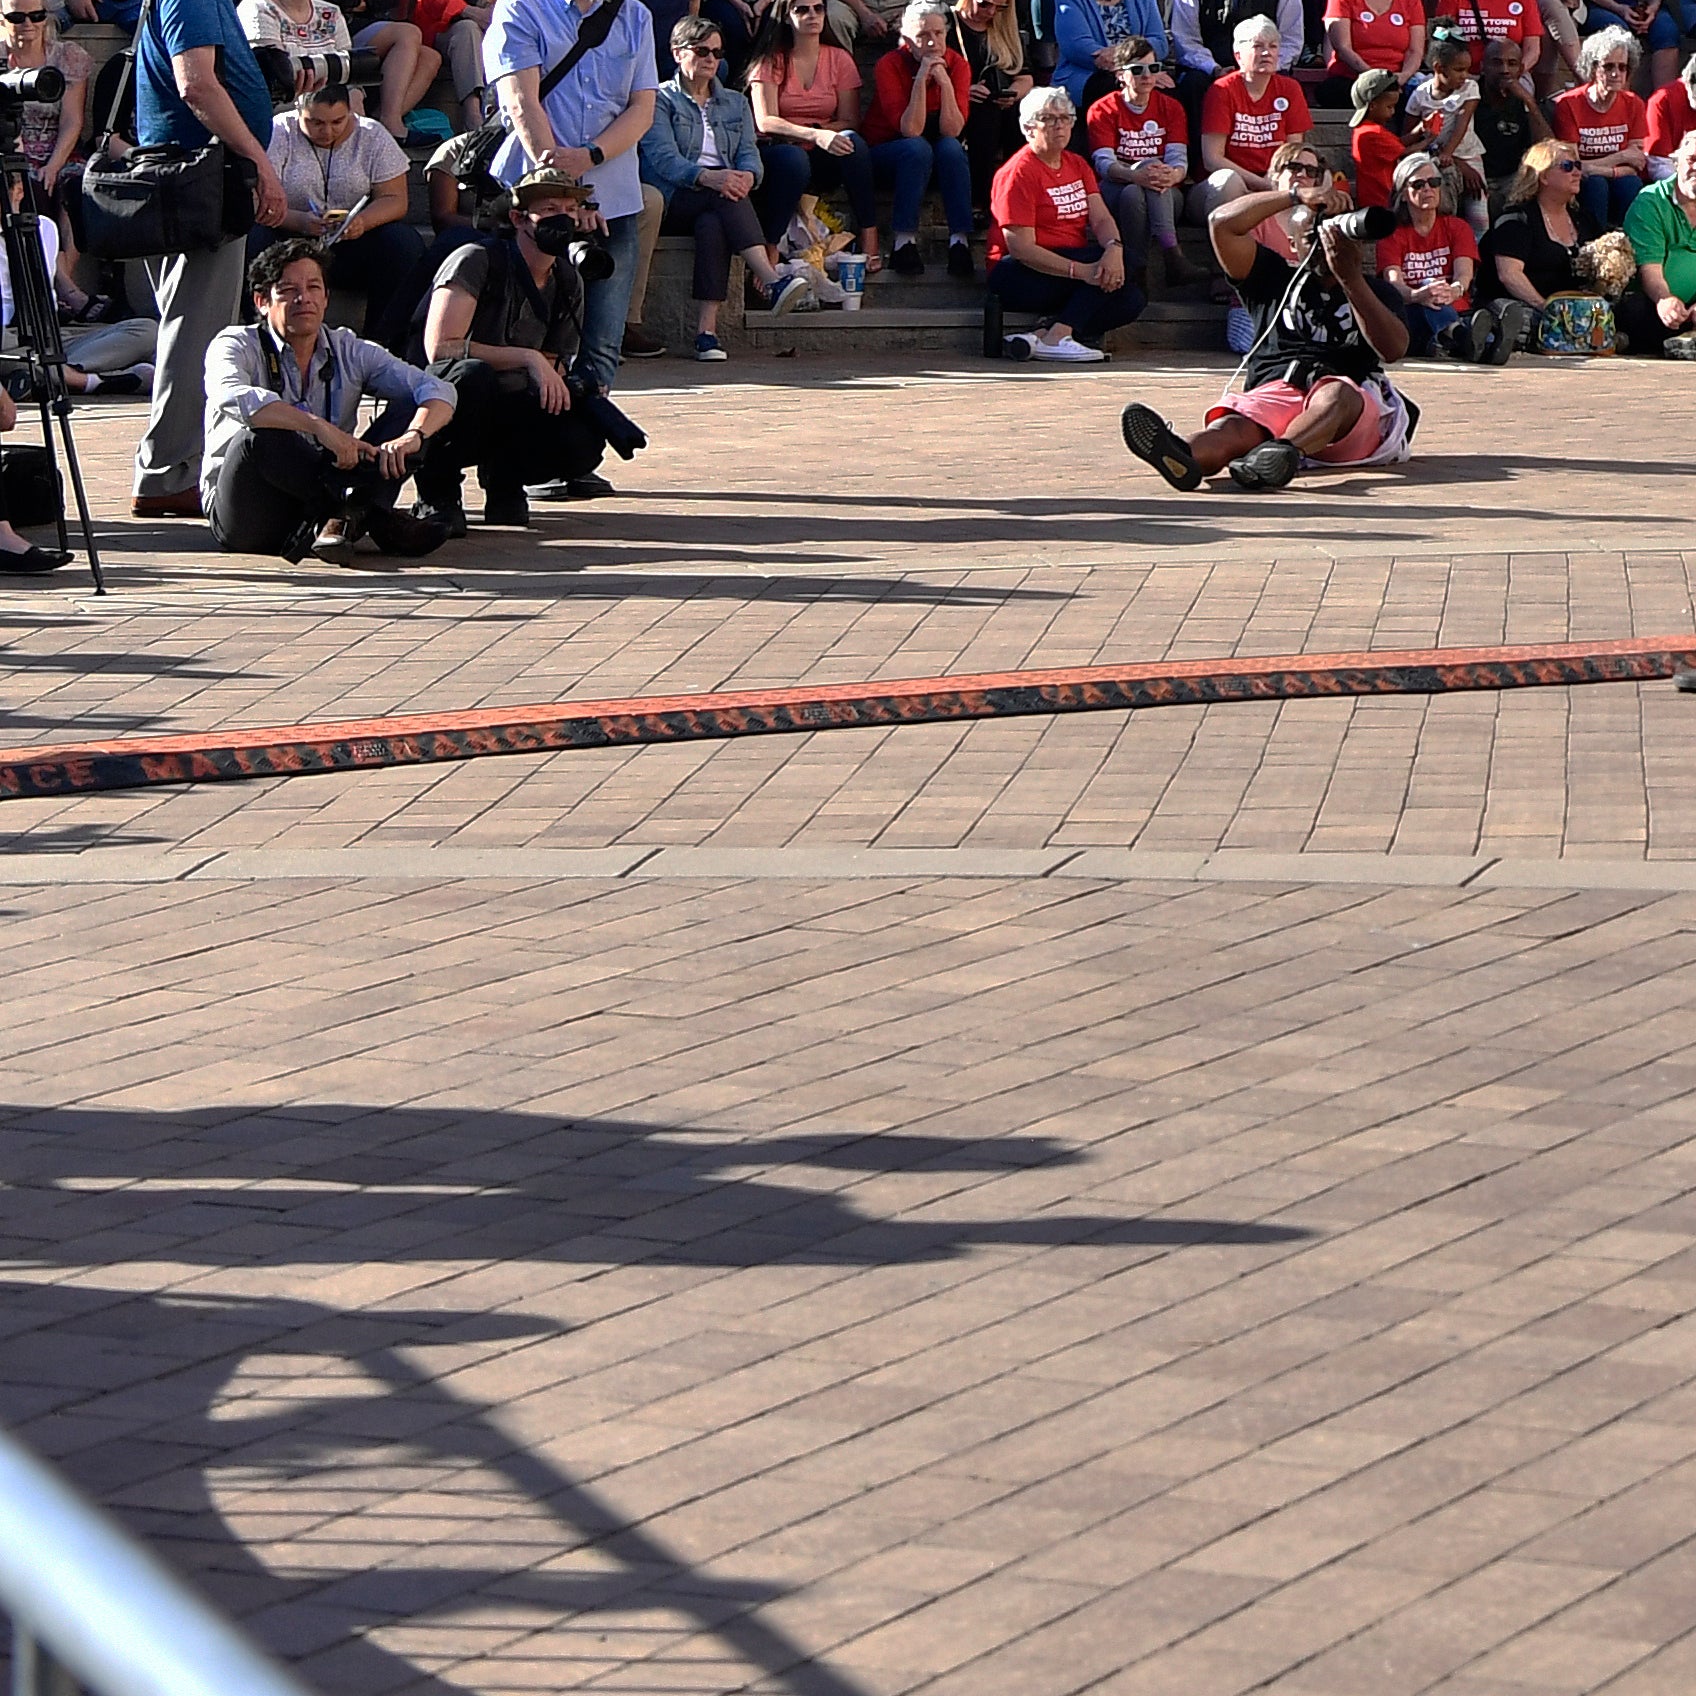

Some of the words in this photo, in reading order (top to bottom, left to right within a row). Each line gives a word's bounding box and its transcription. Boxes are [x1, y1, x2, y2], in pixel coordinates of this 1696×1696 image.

[1459, 18, 1517, 26] EVEYTOWN
[1234, 122, 1279, 132] DEMAND
[1231, 132, 1273, 143] ACTION
[1579, 134, 1625, 144] DEMAND
[1117, 146, 1158, 156] ACTION
[1579, 143, 1619, 152] ACTION
